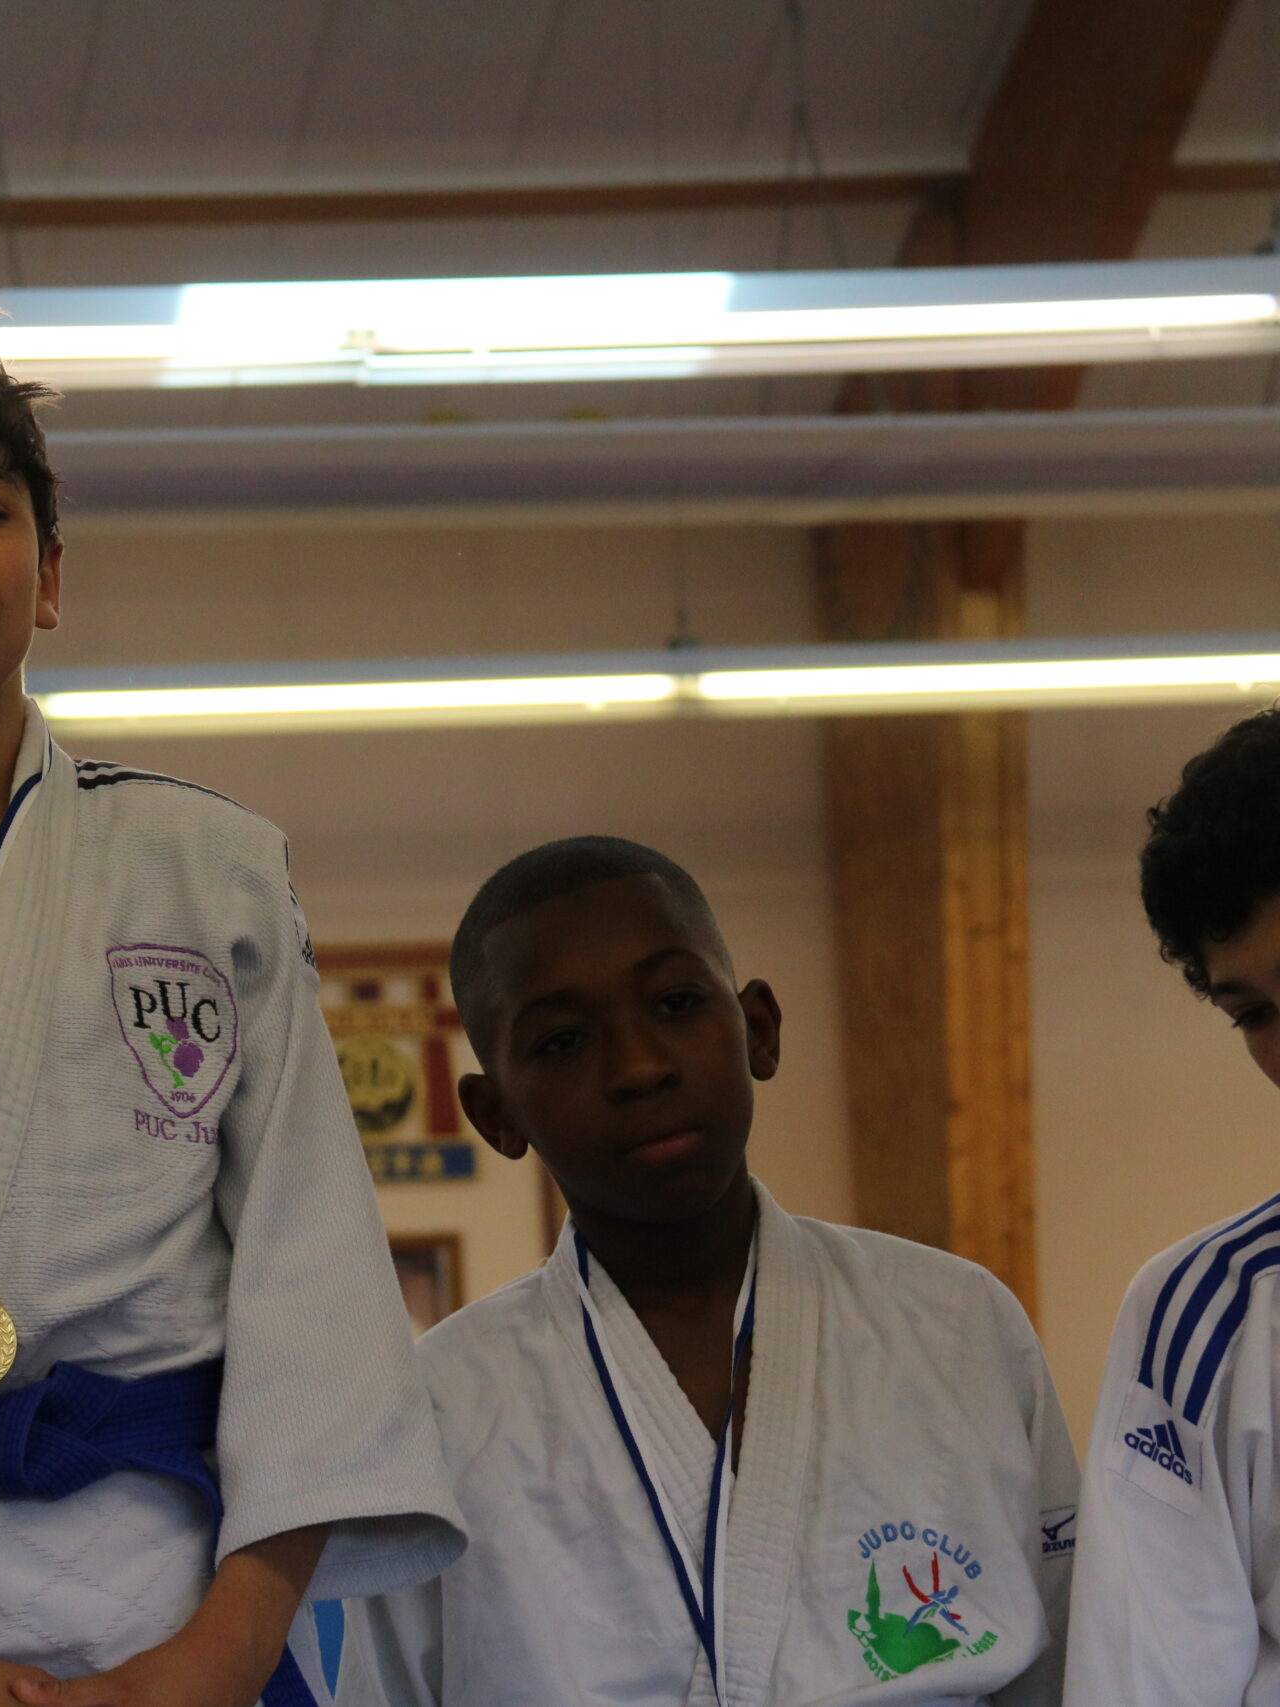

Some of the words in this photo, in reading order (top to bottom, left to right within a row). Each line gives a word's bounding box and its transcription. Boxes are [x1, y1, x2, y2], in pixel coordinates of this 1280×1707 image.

[129, 980, 221, 1042] PUC
[133, 1108, 178, 1141] PUC
[186, 1121, 220, 1145] Ju
[1124, 1432, 1193, 1486] adidas
[857, 1520, 916, 1559] JUDO
[922, 1528, 983, 1580] CLUB
